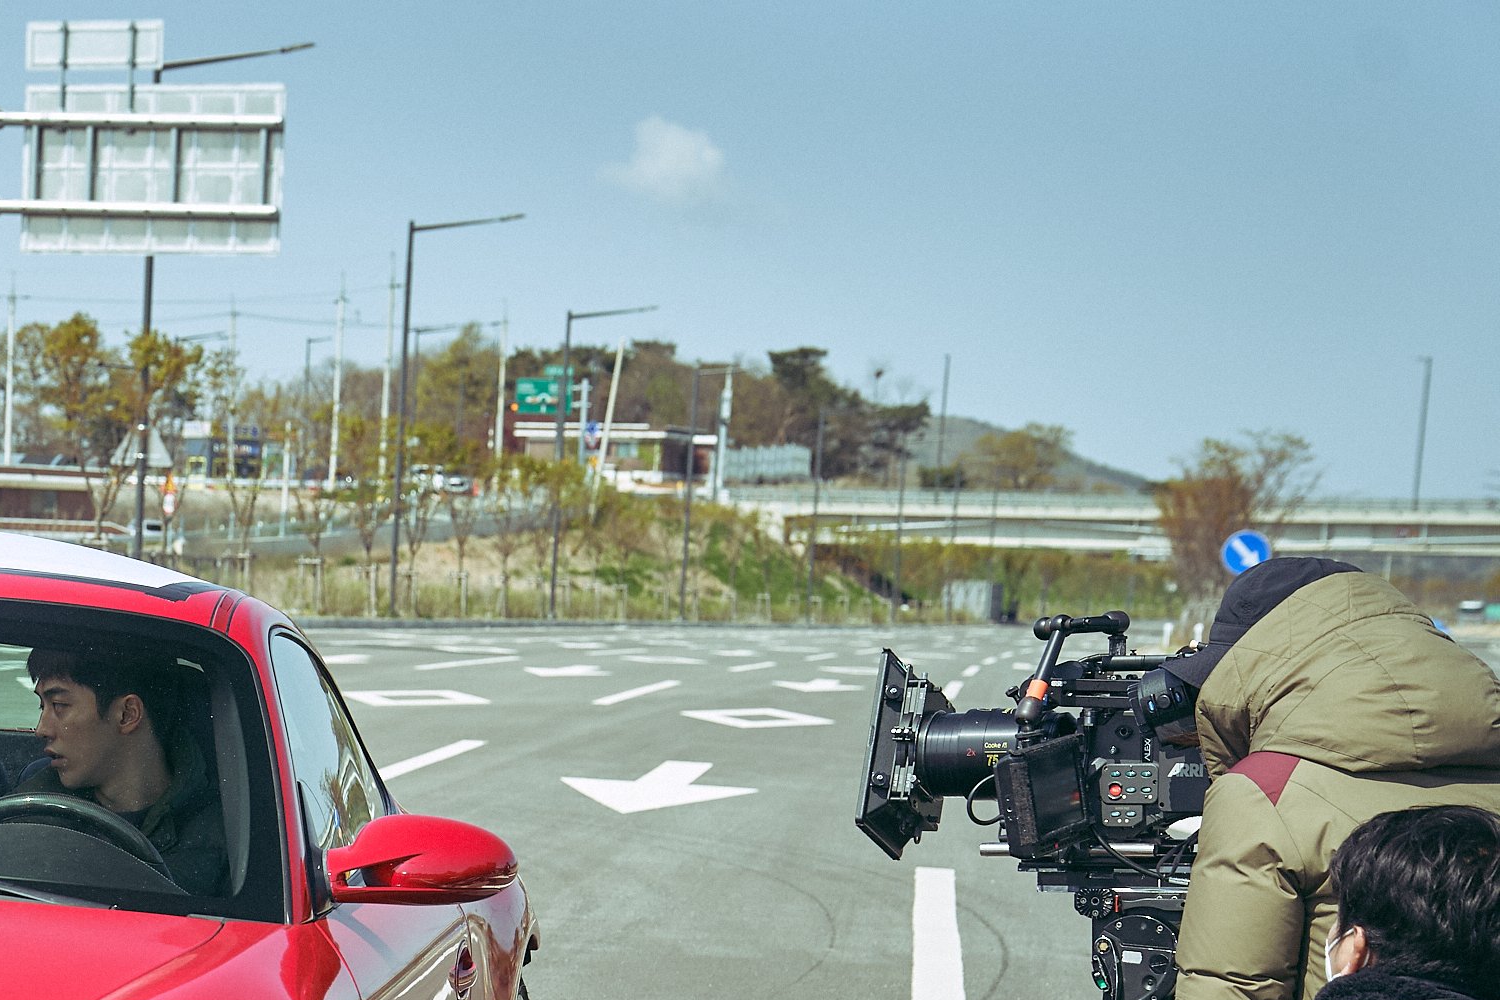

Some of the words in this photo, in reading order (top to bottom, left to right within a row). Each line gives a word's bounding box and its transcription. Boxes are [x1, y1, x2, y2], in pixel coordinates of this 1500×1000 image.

[984, 741, 1001, 749] Cooke
[966, 748, 977, 757] 2x
[1167, 762, 1204, 778] ARRI
